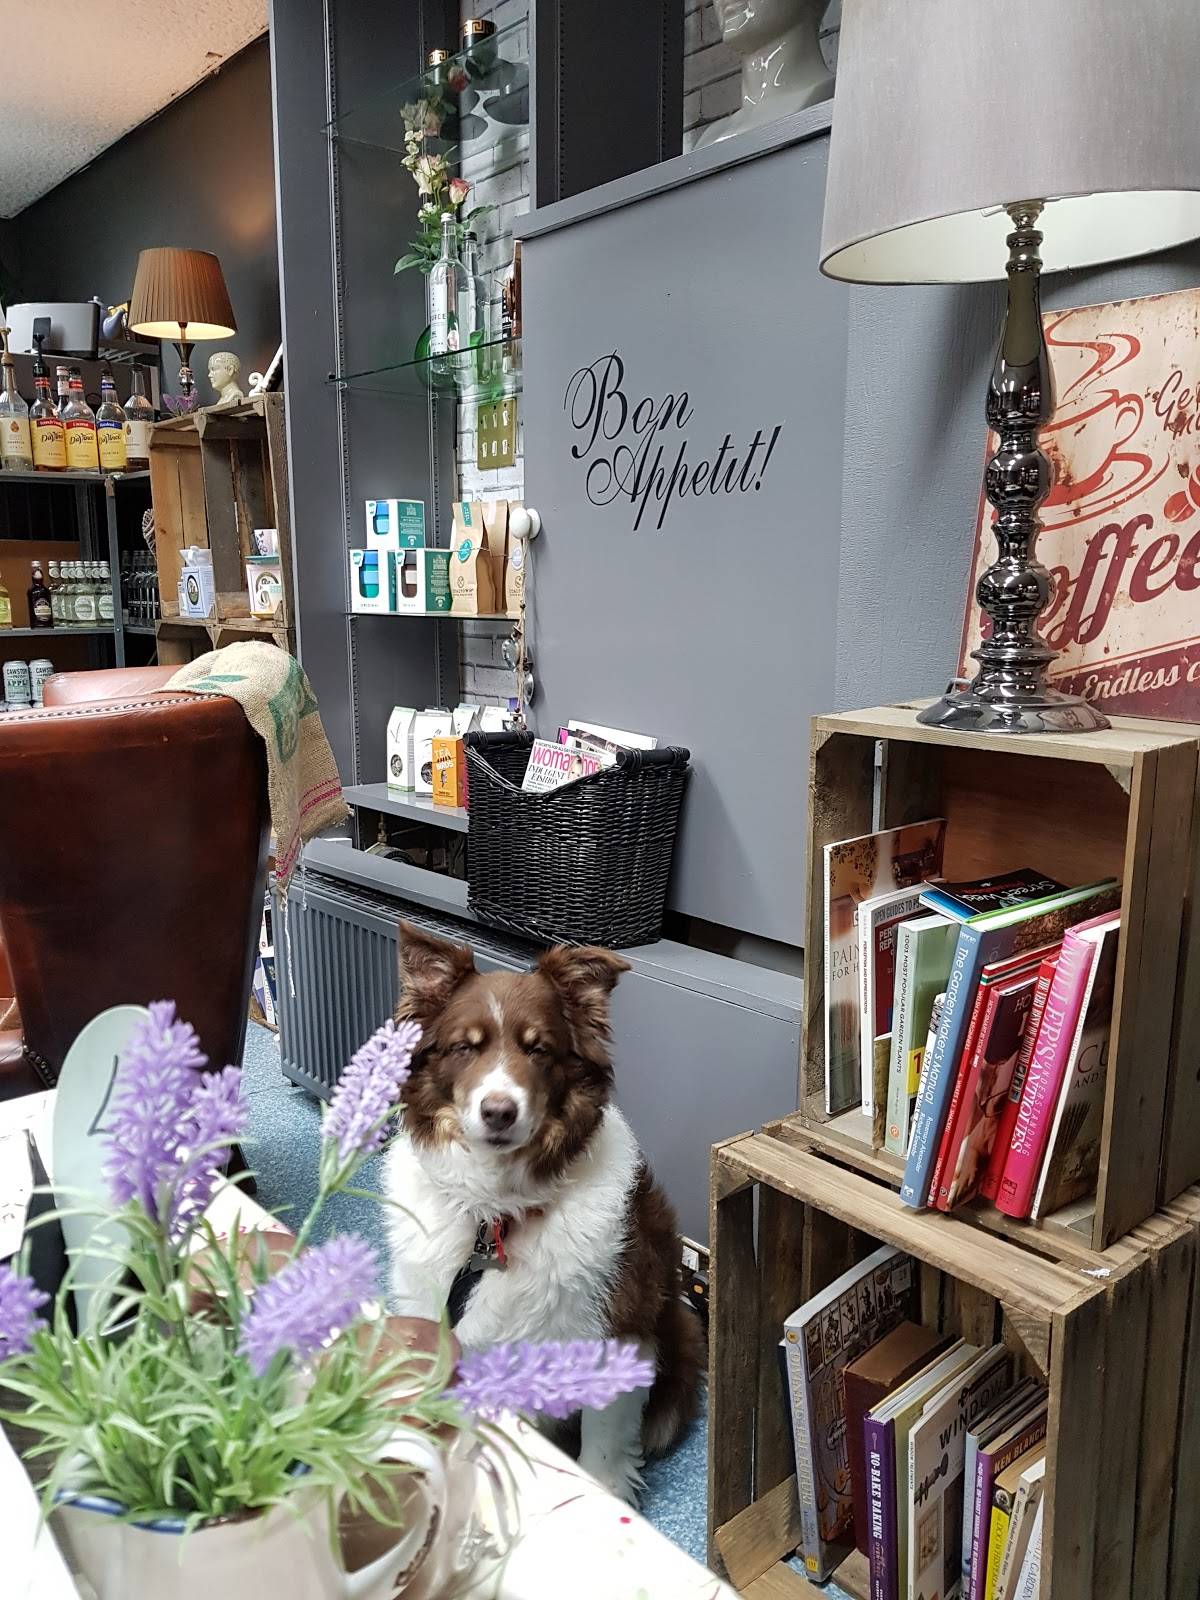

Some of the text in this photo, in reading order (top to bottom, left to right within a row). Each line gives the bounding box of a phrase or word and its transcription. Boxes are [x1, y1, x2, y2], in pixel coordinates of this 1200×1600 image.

[564, 349, 694, 459] Bon
[586, 419, 782, 531] Appetit!
[1081, 661, 1180, 701] Endless
[832, 966, 849, 981] FOR
[1032, 943, 1086, 1063] MILLER'S
[925, 948, 968, 1104] The Garden Maker's Manual
[916, 1112, 925, 1132] Richard
[916, 1116, 933, 1172] Rosemary Alexander
[1007, 1058, 1047, 1153] ANTIQUES
[1020, 1061, 1055, 1156] UNDERSTANDING
[871, 1452, 882, 1538] NO-BAKE BAKING
[994, 1453, 1011, 1472] KEN
[1022, 1563, 1039, 1600] GARDEN
